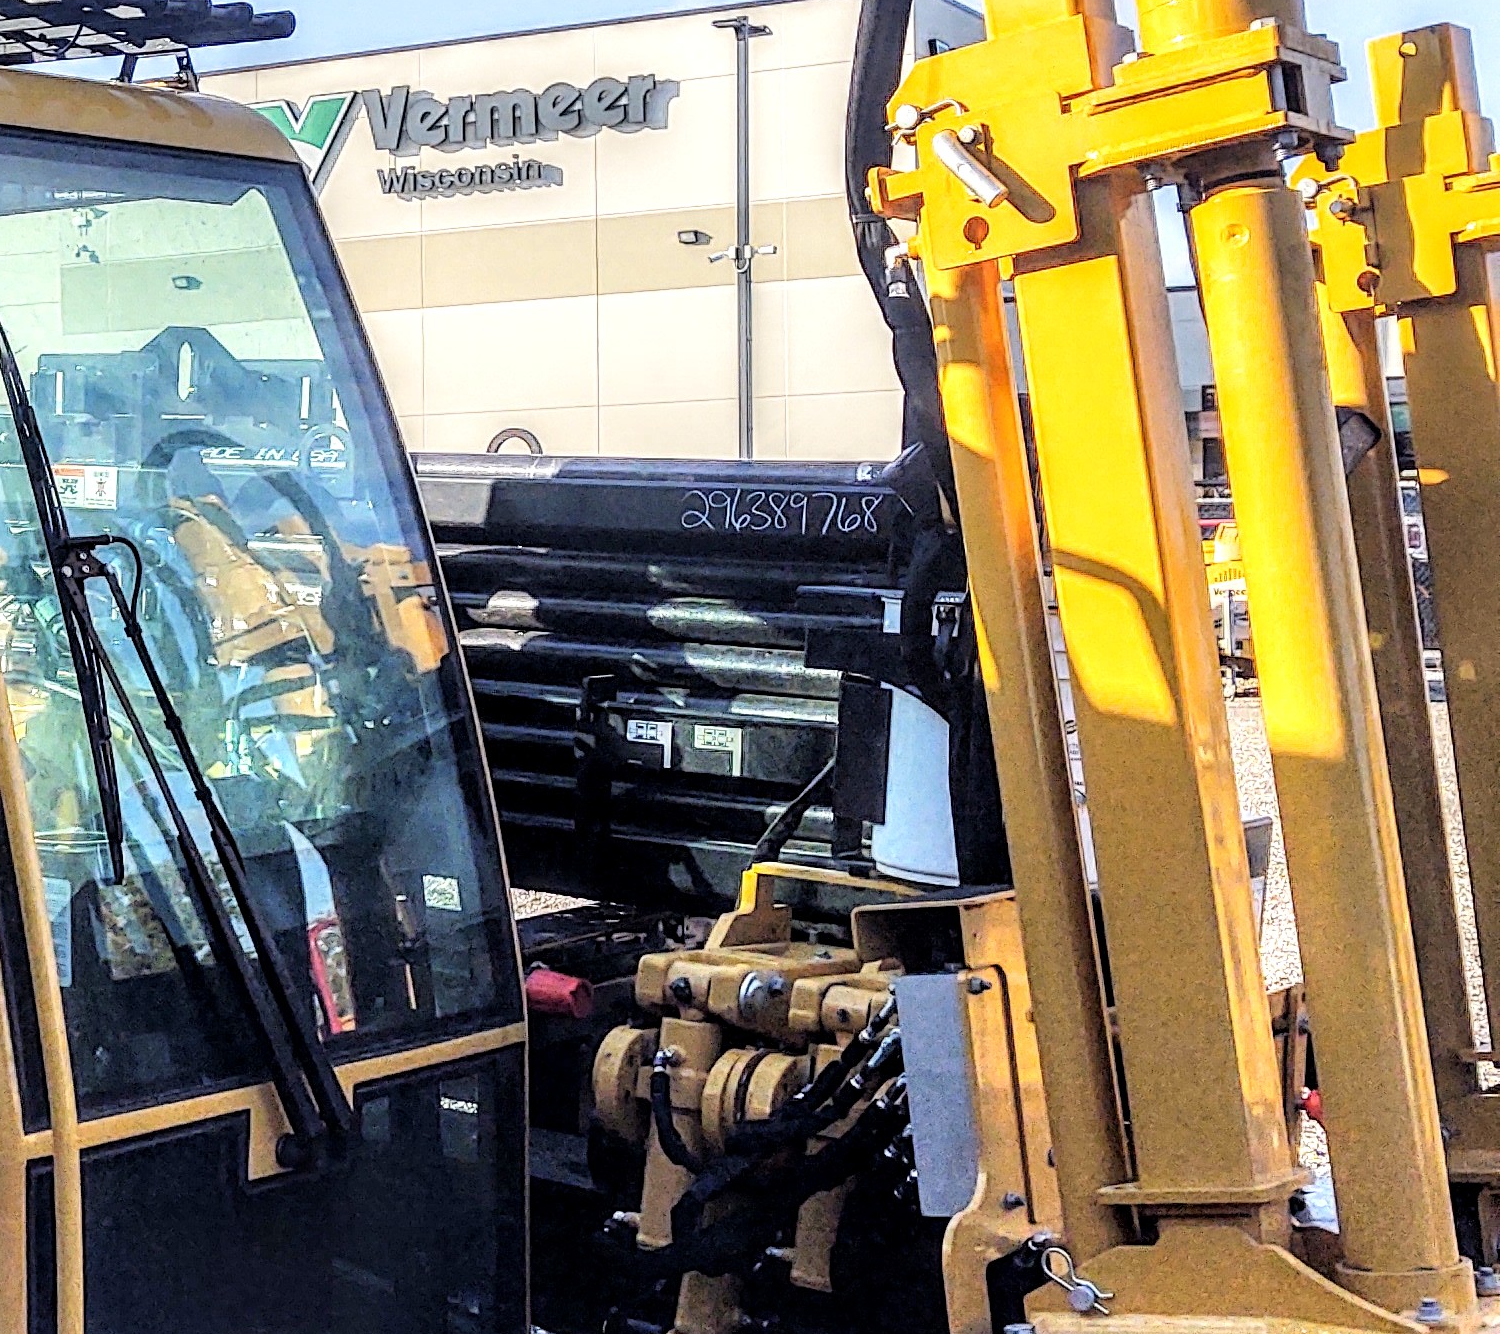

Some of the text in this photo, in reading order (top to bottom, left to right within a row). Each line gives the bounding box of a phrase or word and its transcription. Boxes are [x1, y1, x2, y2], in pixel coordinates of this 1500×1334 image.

[362, 74, 658, 152] Vermeer
[378, 154, 548, 195] Wisconsin
[254, 447, 285, 460] IN
